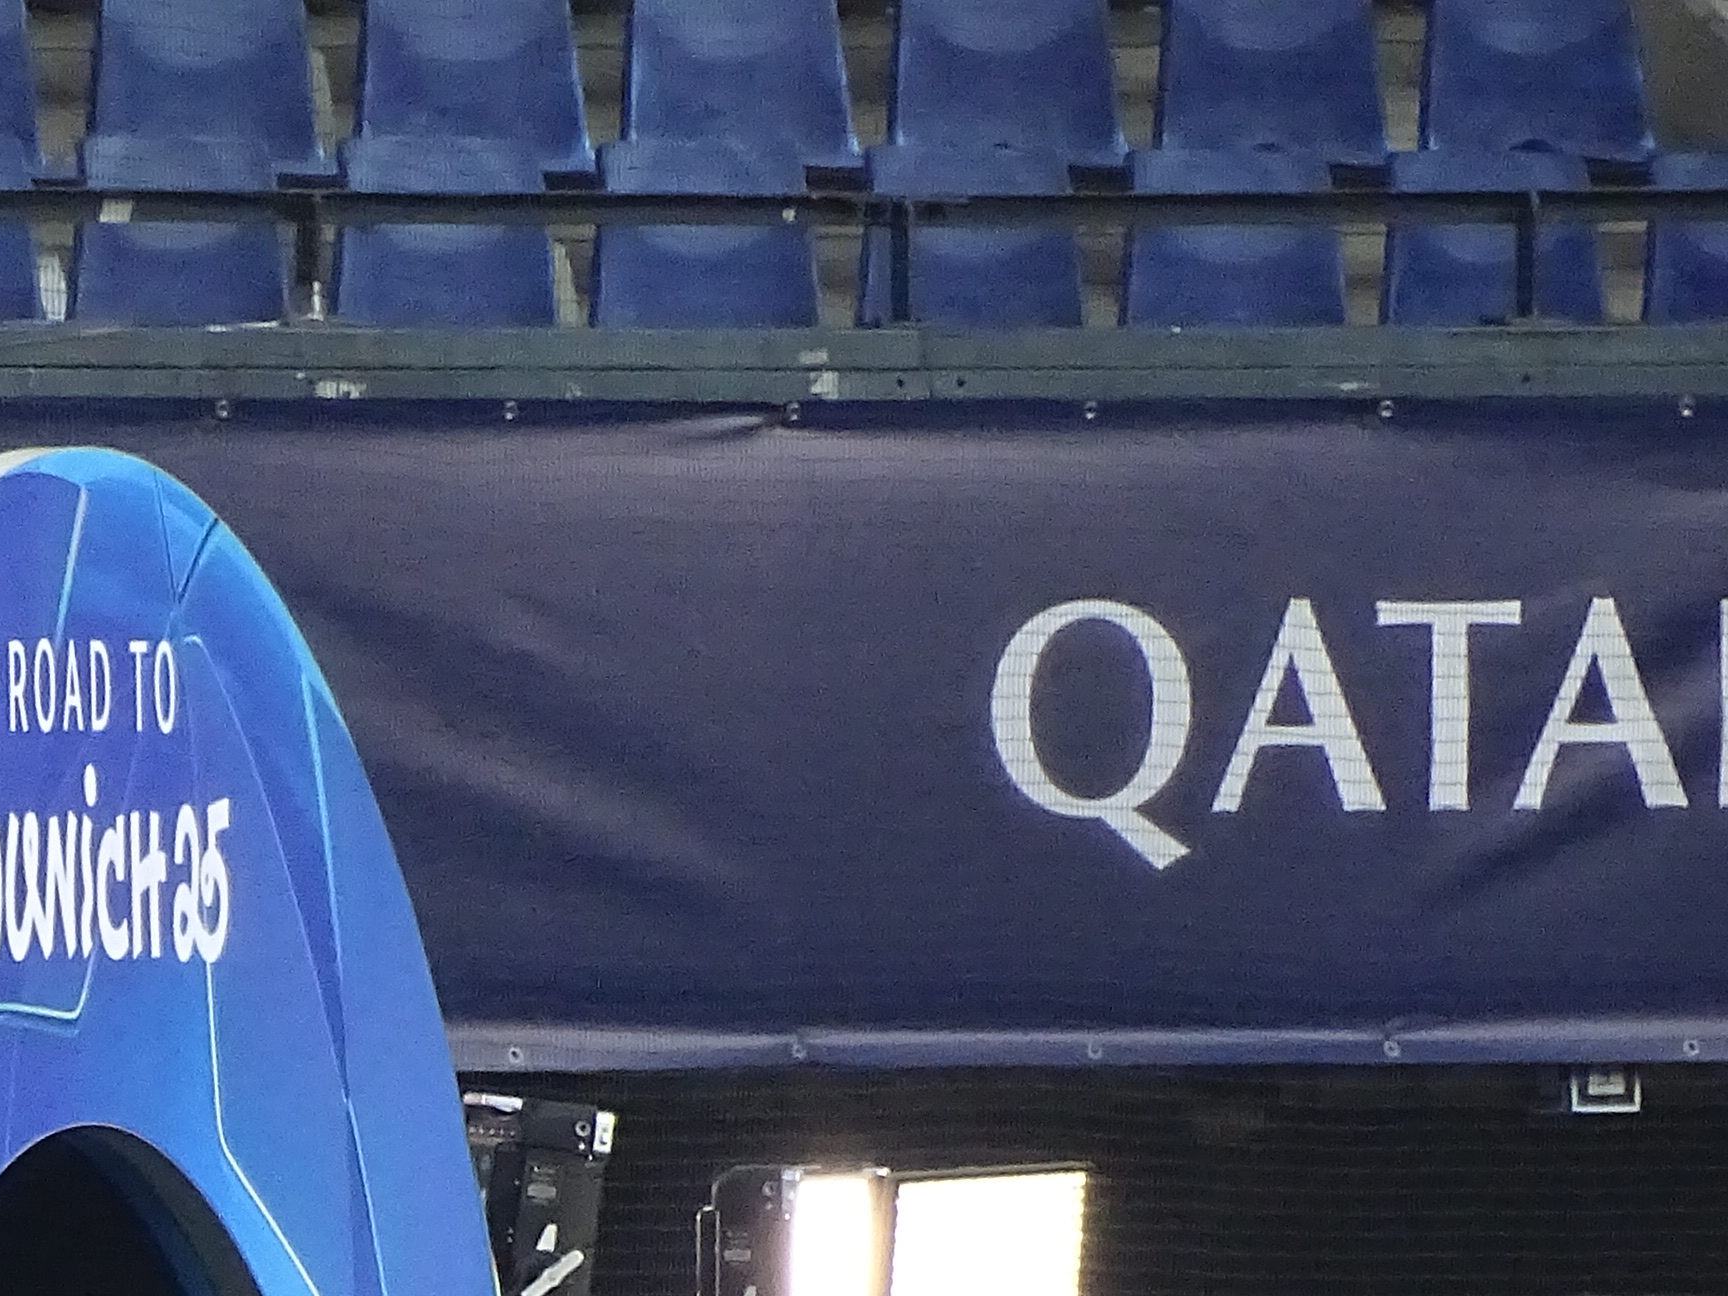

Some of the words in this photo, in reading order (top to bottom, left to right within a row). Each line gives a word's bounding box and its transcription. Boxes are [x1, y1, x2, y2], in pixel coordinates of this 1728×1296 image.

[8, 637, 112, 734] ROAD
[129, 639, 177, 735] TO
[990, 597, 1728, 871] QATA
